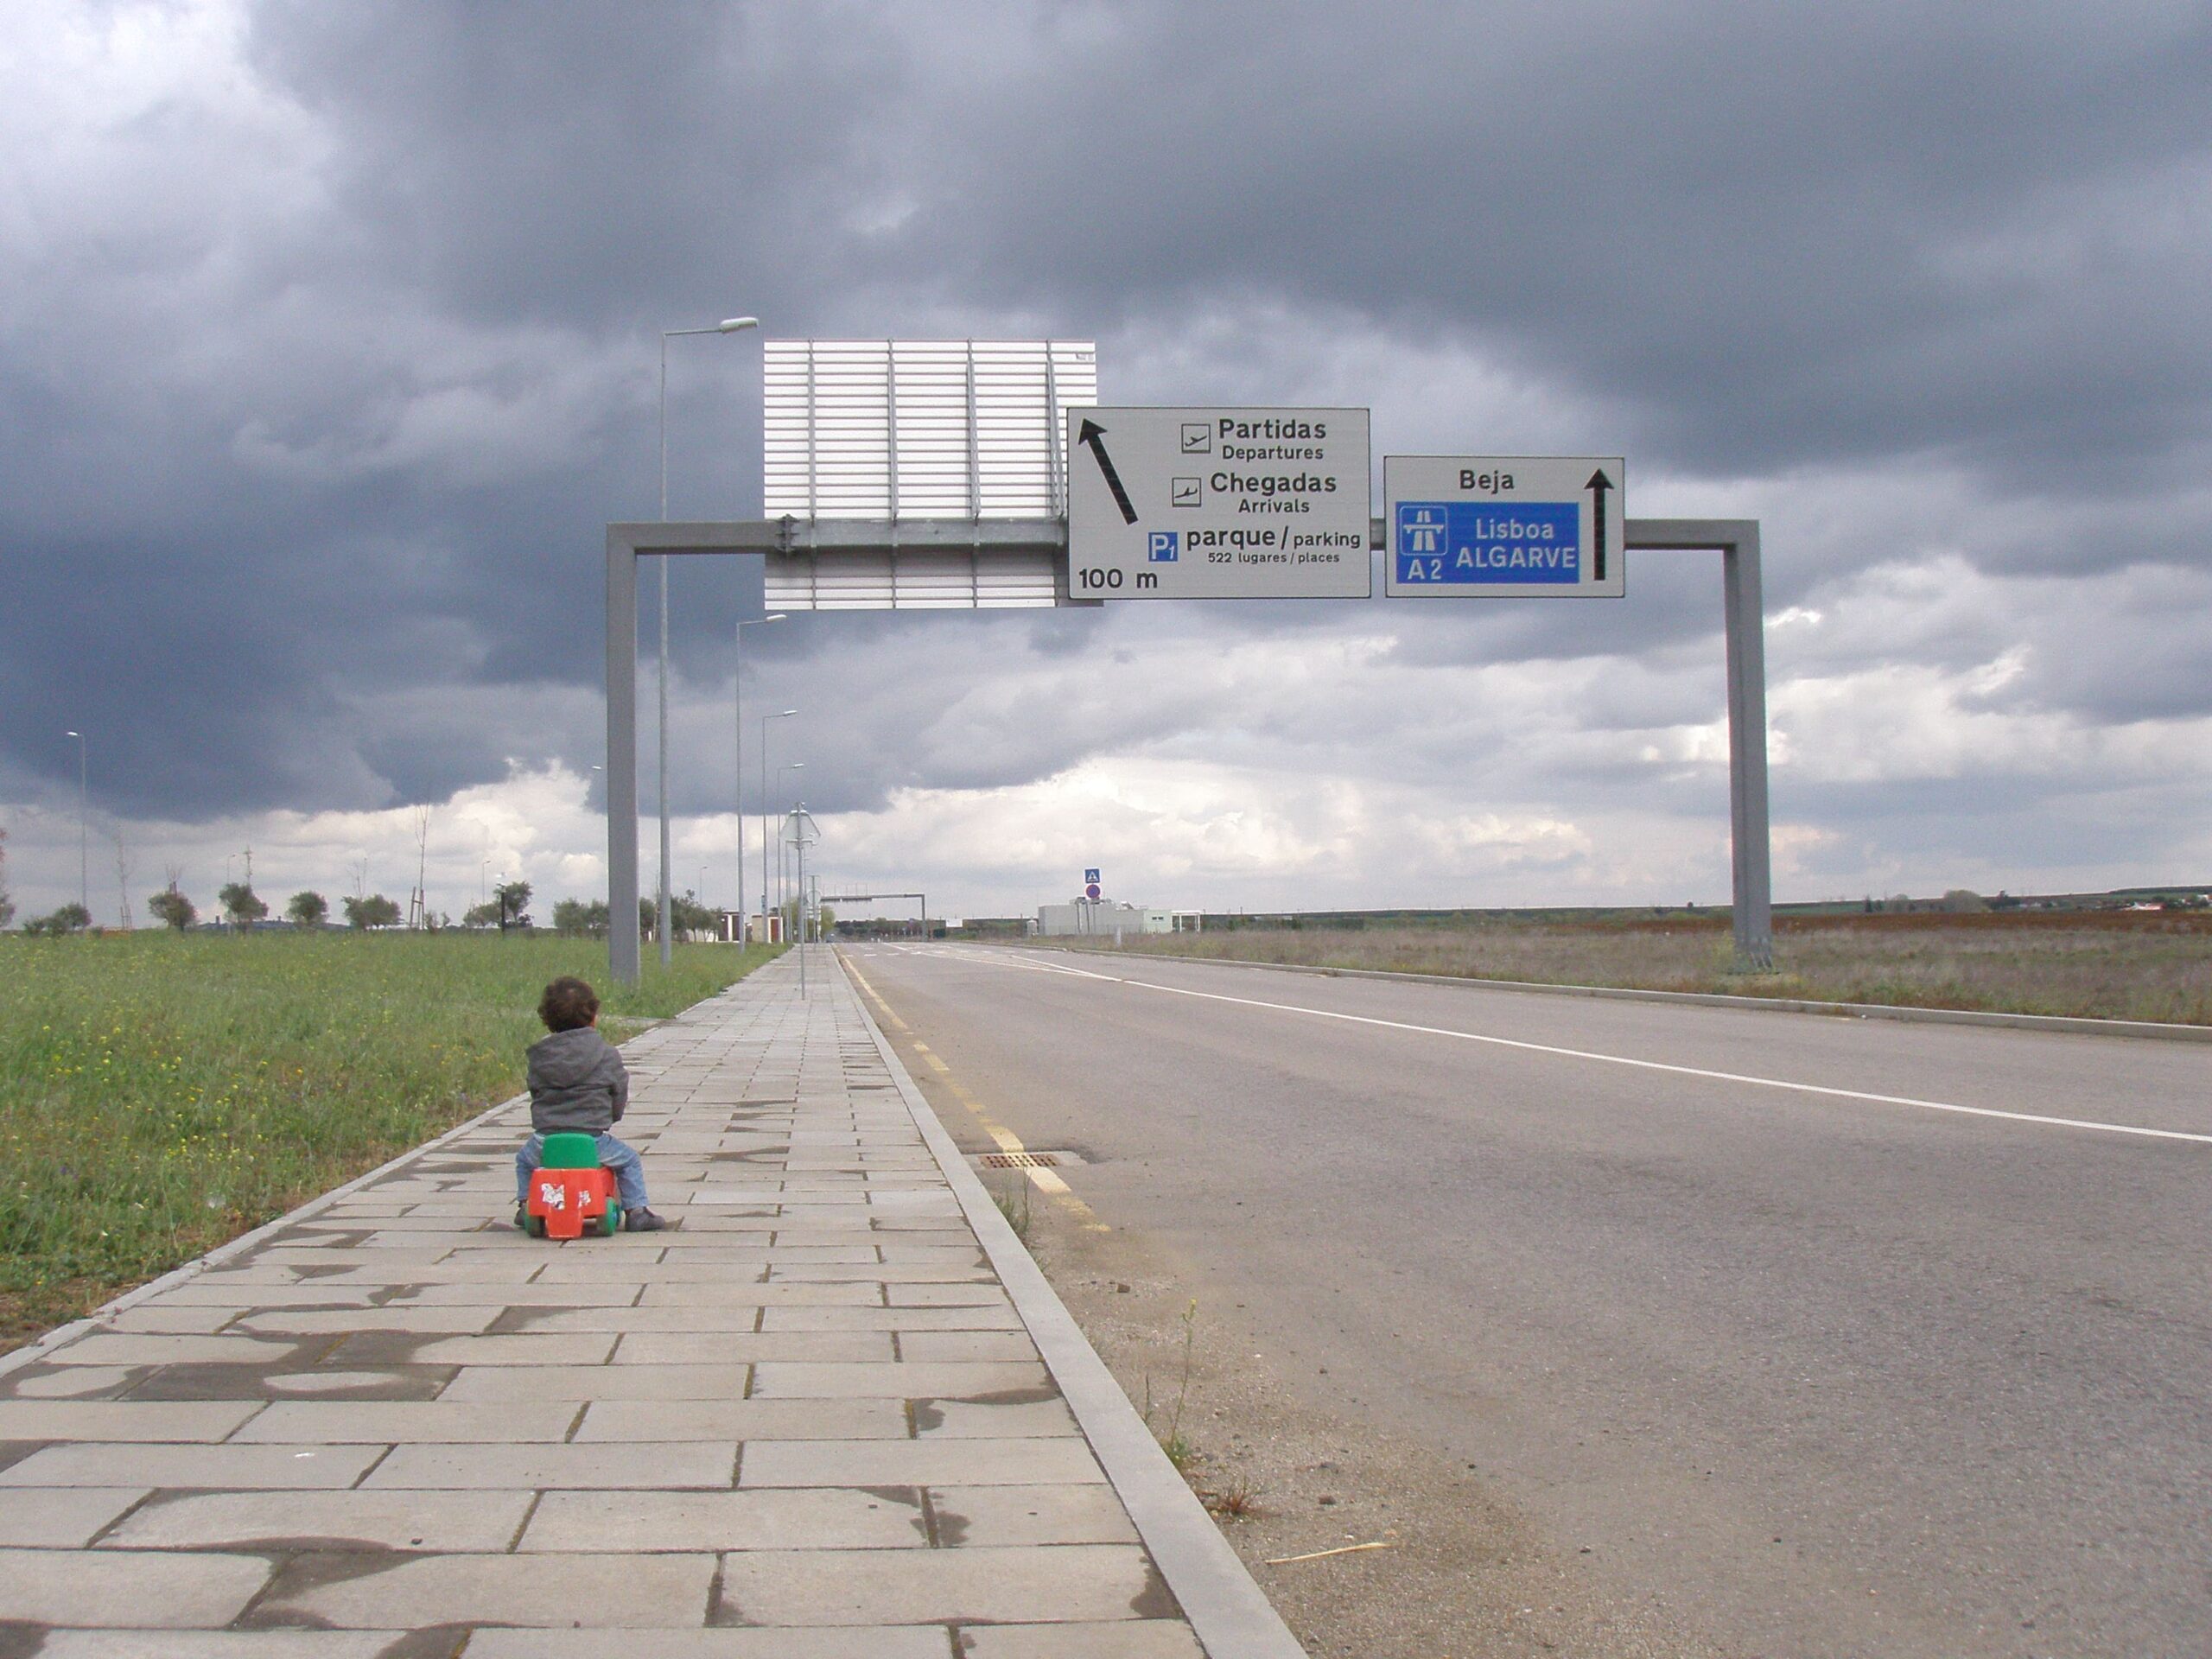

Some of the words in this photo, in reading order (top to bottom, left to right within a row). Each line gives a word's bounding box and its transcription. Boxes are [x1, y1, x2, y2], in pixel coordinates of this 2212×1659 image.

[1219, 418, 1326, 439] Partidas
[1222, 444, 1324, 462] Departures
[1210, 472, 1337, 496] Chegadas
[1459, 469, 1514, 494] Beja
[1238, 499, 1310, 513] Arrivals
[1476, 518, 1554, 540] Lisboa
[1294, 531, 1361, 549] parking
[1208, 552, 1232, 563] 522
[1238, 550, 1288, 564] lugares
[1298, 550, 1340, 564] places
[1456, 546, 1576, 569] ALGARVE
[1078, 568, 1123, 588] 100
[1136, 571, 1158, 588] m
